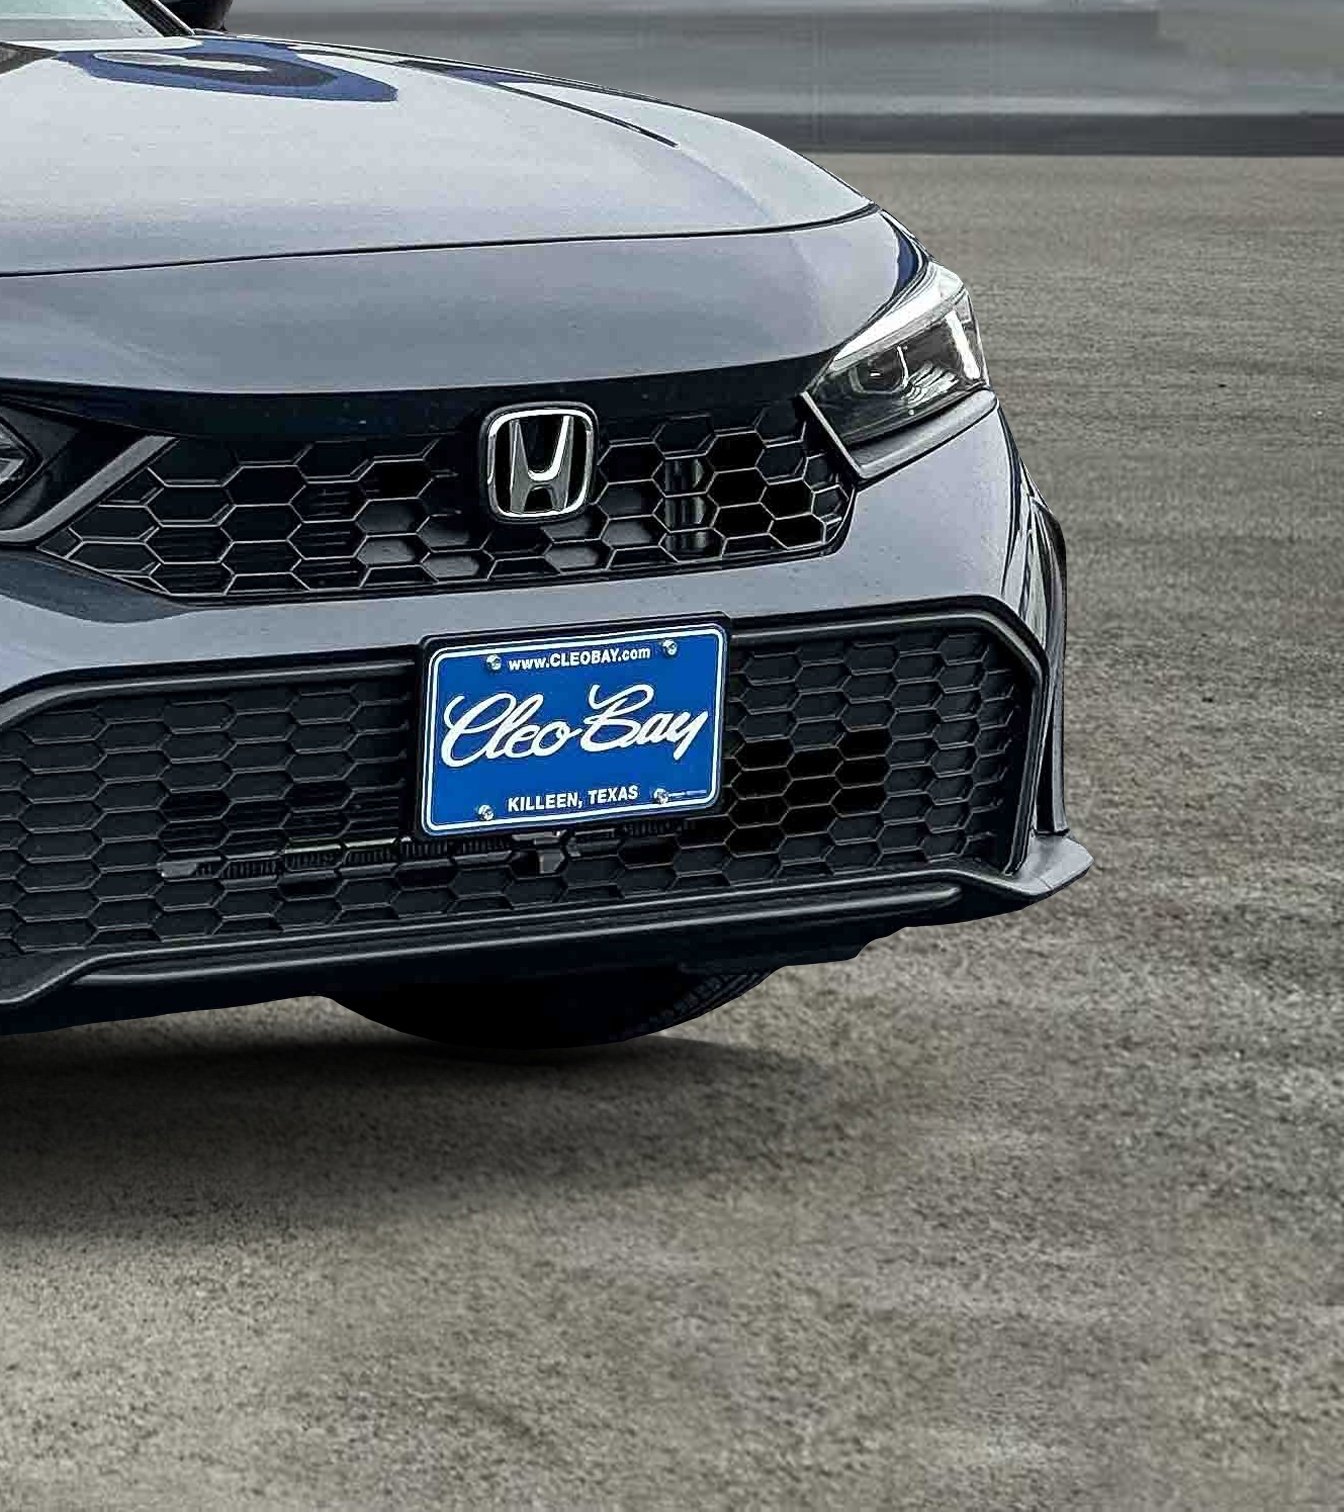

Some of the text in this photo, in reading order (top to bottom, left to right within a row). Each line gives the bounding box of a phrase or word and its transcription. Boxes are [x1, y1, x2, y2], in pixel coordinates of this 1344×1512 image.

[507, 645, 651, 671] www.CLEOBAY.com
[440, 684, 709, 768] Cleo Bay
[507, 785, 639, 813] KILLEEN, TEXAS
